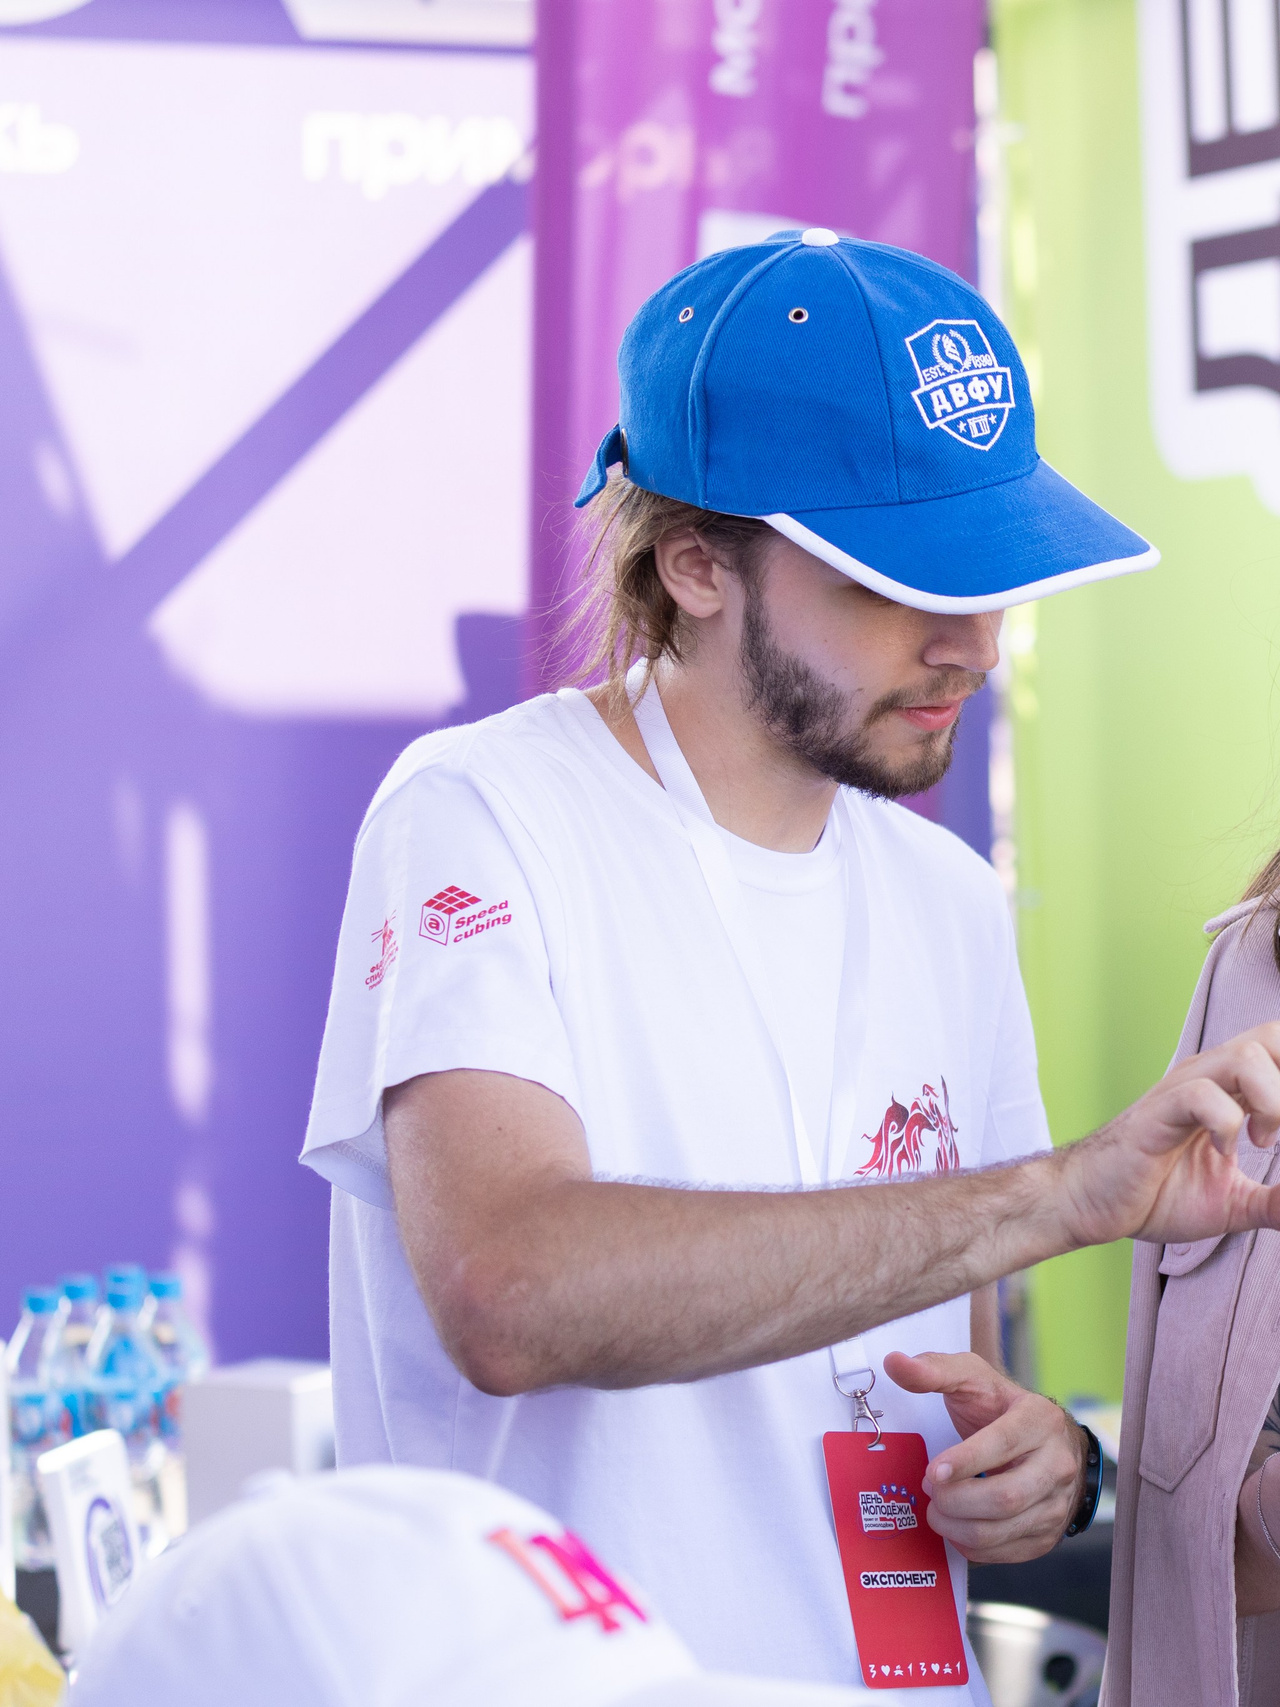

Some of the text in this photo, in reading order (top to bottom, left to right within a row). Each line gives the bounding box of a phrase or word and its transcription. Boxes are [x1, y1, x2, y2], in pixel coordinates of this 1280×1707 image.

[922, 365, 945, 382] EST.
[930, 375, 1003, 418] ДВФУ
[455, 900, 509, 929] Speed
[453, 913, 512, 943] cubing
[861, 1494, 883, 1505] ДЕНЬ
[863, 1503, 911, 1516] МОЛОДЁЖИ
[897, 1516, 916, 1528] 2025
[862, 1573, 936, 1586] ЭКСПОНЕНТ
